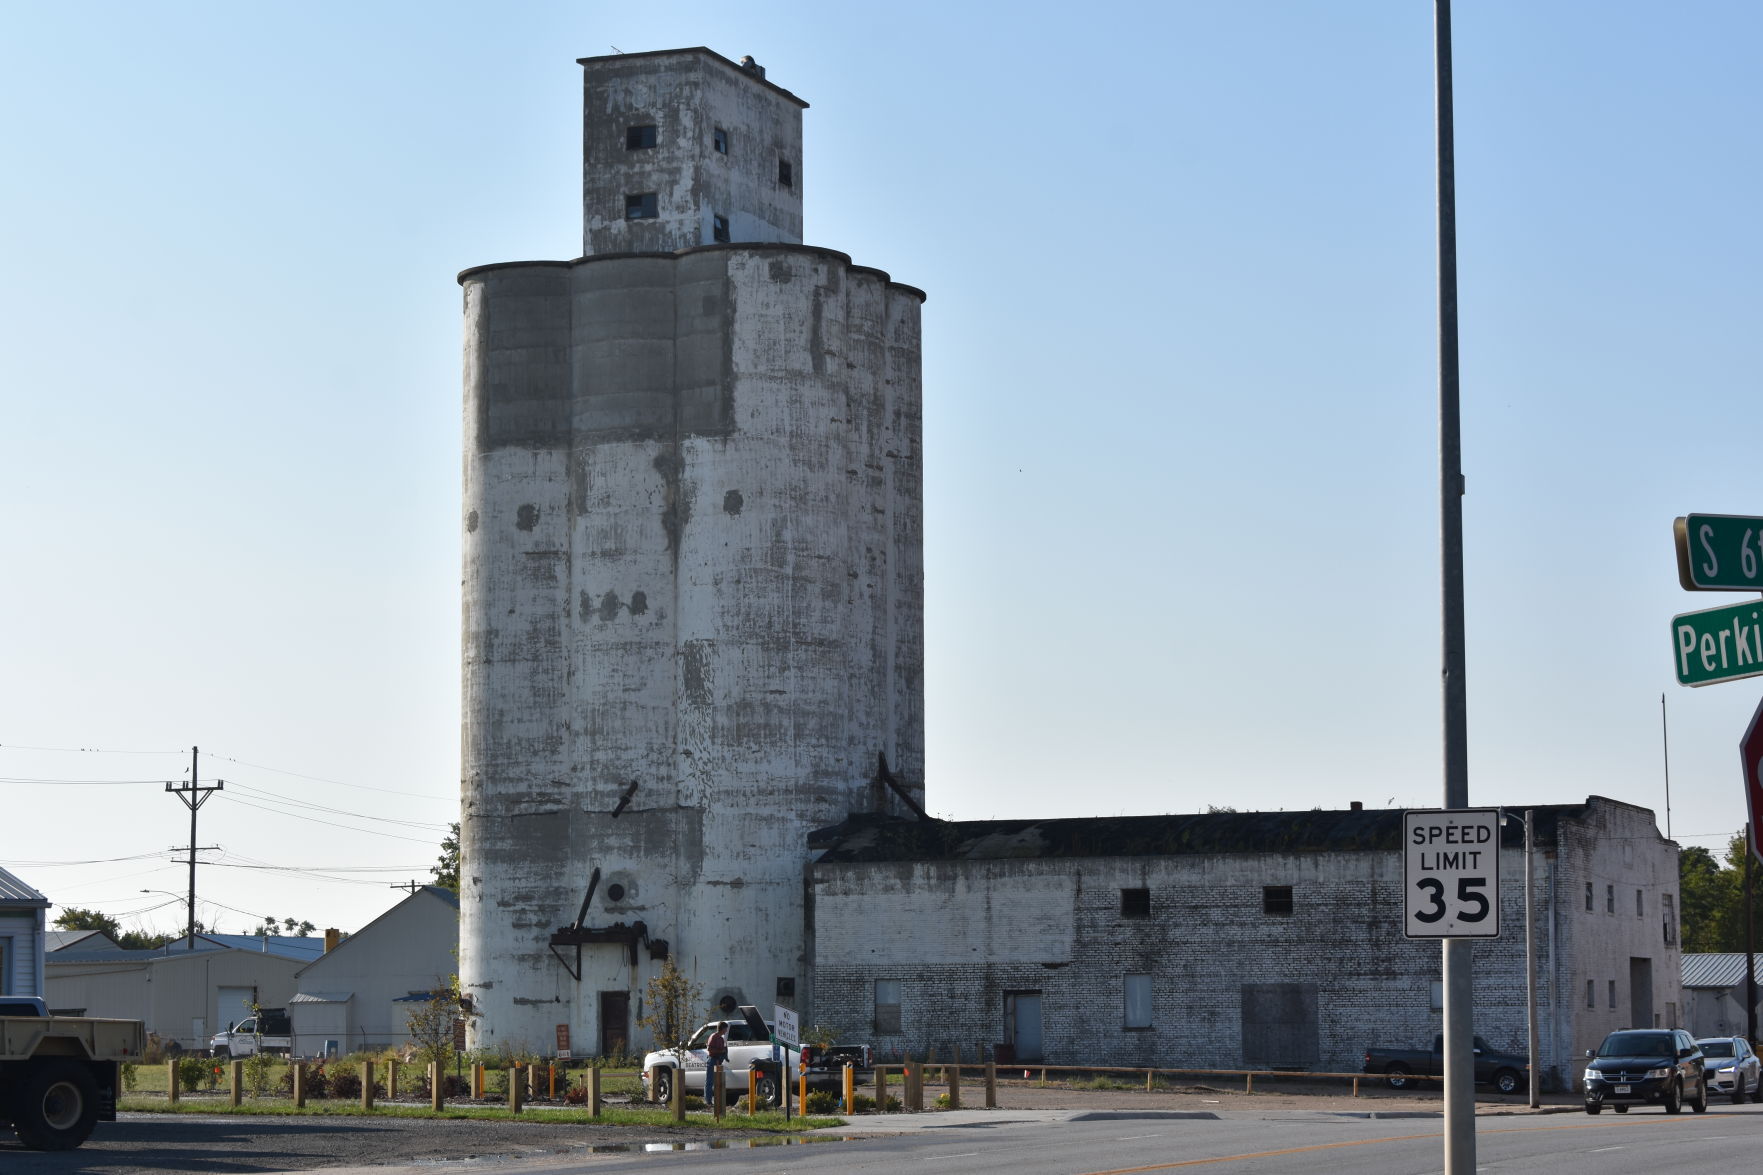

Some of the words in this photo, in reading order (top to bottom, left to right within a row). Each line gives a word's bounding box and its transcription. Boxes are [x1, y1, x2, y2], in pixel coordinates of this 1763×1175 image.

[1699, 523, 1718, 578] S
[1412, 825, 1491, 845] SPEED
[1421, 851, 1482, 870] LIMIT
[1414, 877, 1490, 923] 35
[783, 1010, 791, 1020] NO
[777, 1028, 796, 1042] VEHICLES
[778, 1019, 795, 1032] MOTOR
